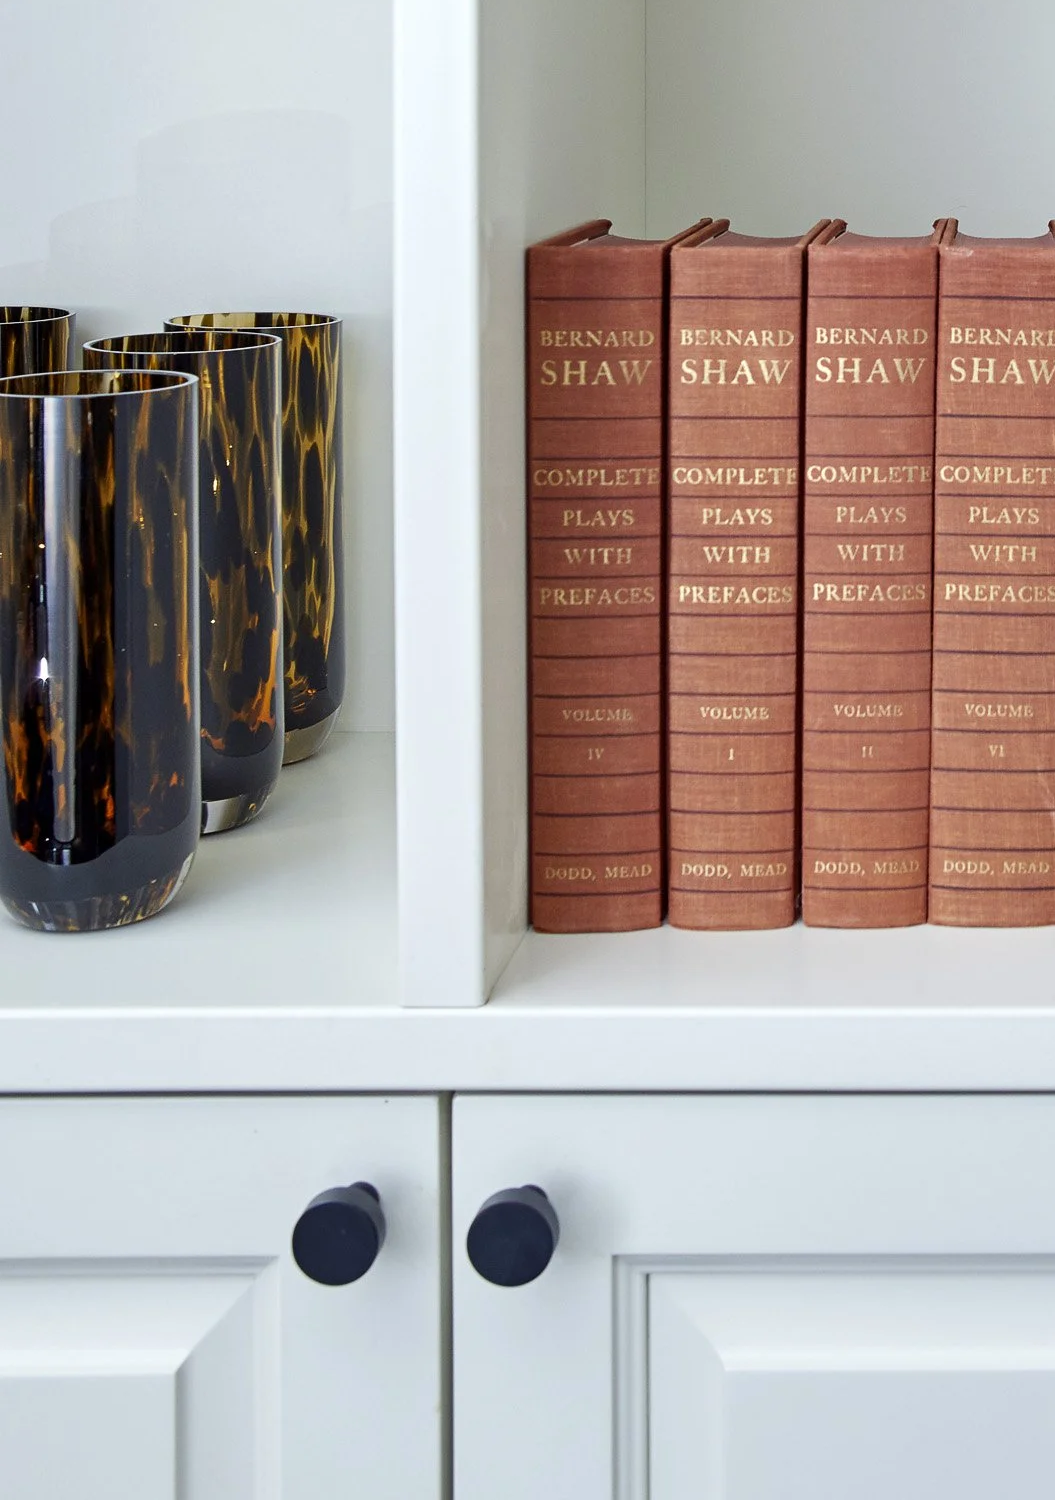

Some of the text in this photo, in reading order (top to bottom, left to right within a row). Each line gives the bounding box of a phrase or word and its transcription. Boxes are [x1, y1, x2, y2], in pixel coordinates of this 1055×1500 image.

[540, 330, 655, 348] BERNARD
[680, 329, 795, 347] BERNARD
[815, 327, 929, 345] BERNARD
[540, 359, 653, 386] SHAW
[680, 358, 793, 385] SHAW
[815, 356, 925, 384] SHAW
[533, 467, 661, 487] COMPLETE
[672, 467, 797, 485] COMPLETE
[807, 465, 932, 483] COMPLETE
[563, 509, 634, 527] PLAYS
[702, 508, 773, 526] PLAYS
[836, 506, 907, 524] PLAYS
[968, 506, 1039, 525] PLAYS
[564, 547, 632, 565] WITH
[703, 546, 771, 564] WITH
[837, 544, 905, 561] WITH
[969, 544, 1037, 563] WITH
[540, 586, 655, 605] PREFACES
[679, 585, 793, 605] PREFACES
[813, 583, 926, 601] PREFACES
[700, 707, 769, 721] VOLUME
[833, 704, 904, 717] VOLUME
[965, 704, 1034, 717] VOLUME
[604, 864, 652, 879] MEAD
[681, 863, 787, 879] DODD, MEAD
[814, 860, 920, 876] DODD, MEAD
[943, 861, 1050, 877] DODD, MEAD
